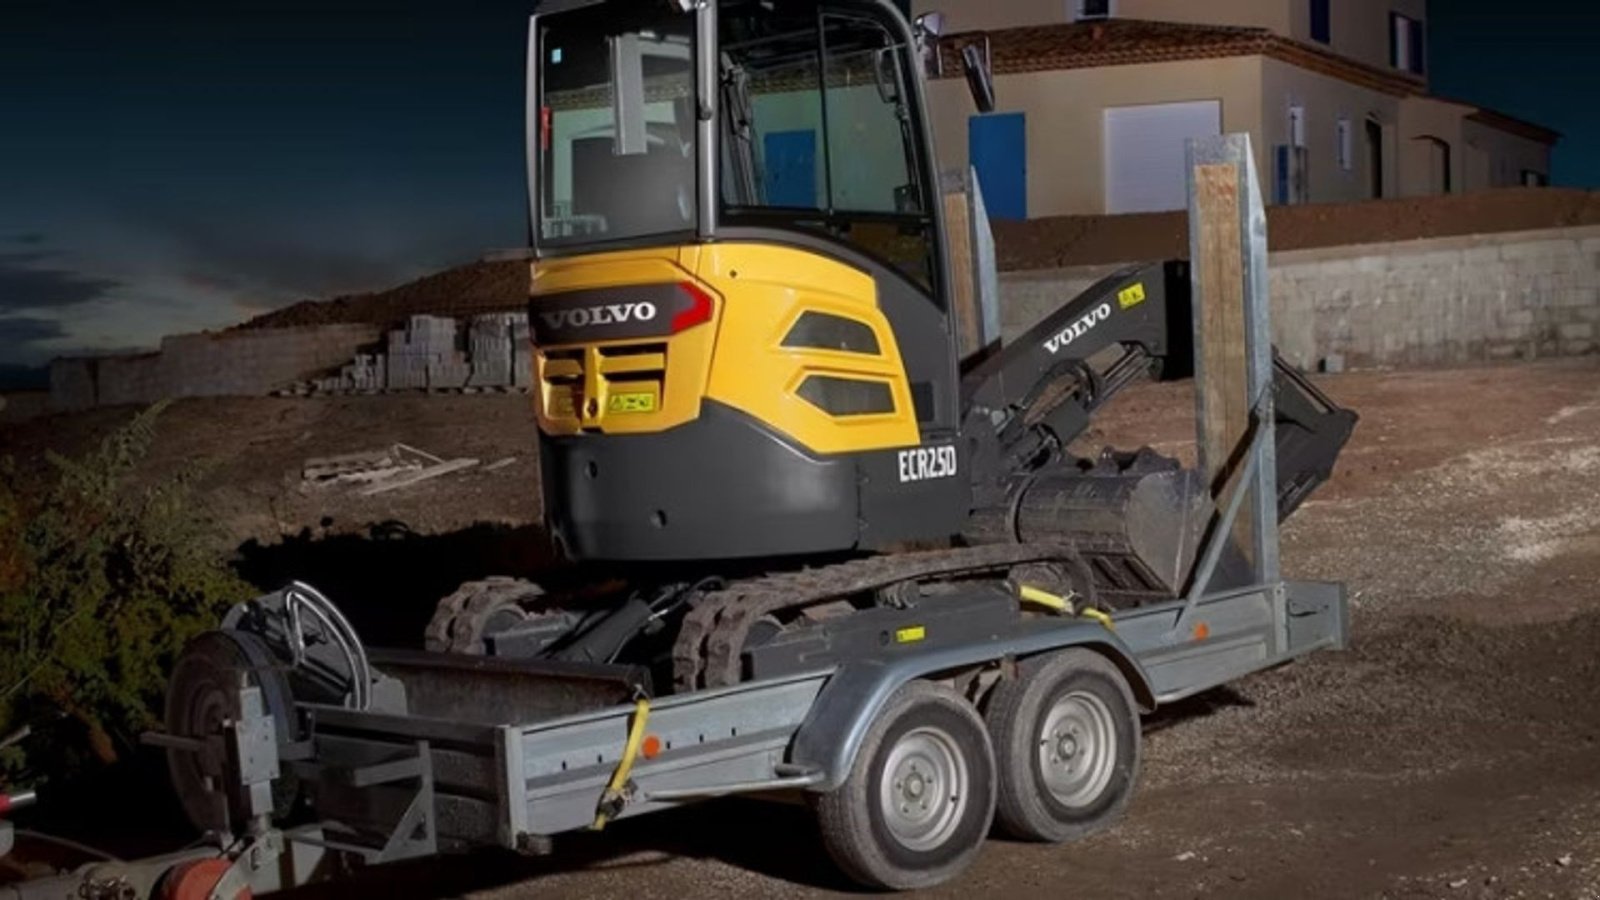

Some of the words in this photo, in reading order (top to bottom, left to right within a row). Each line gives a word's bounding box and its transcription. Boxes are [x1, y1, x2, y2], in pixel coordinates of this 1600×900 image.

[541, 302, 656, 329] VOLVO
[1043, 303, 1111, 354] VOLVO
[898, 445, 956, 482] ECR25D
